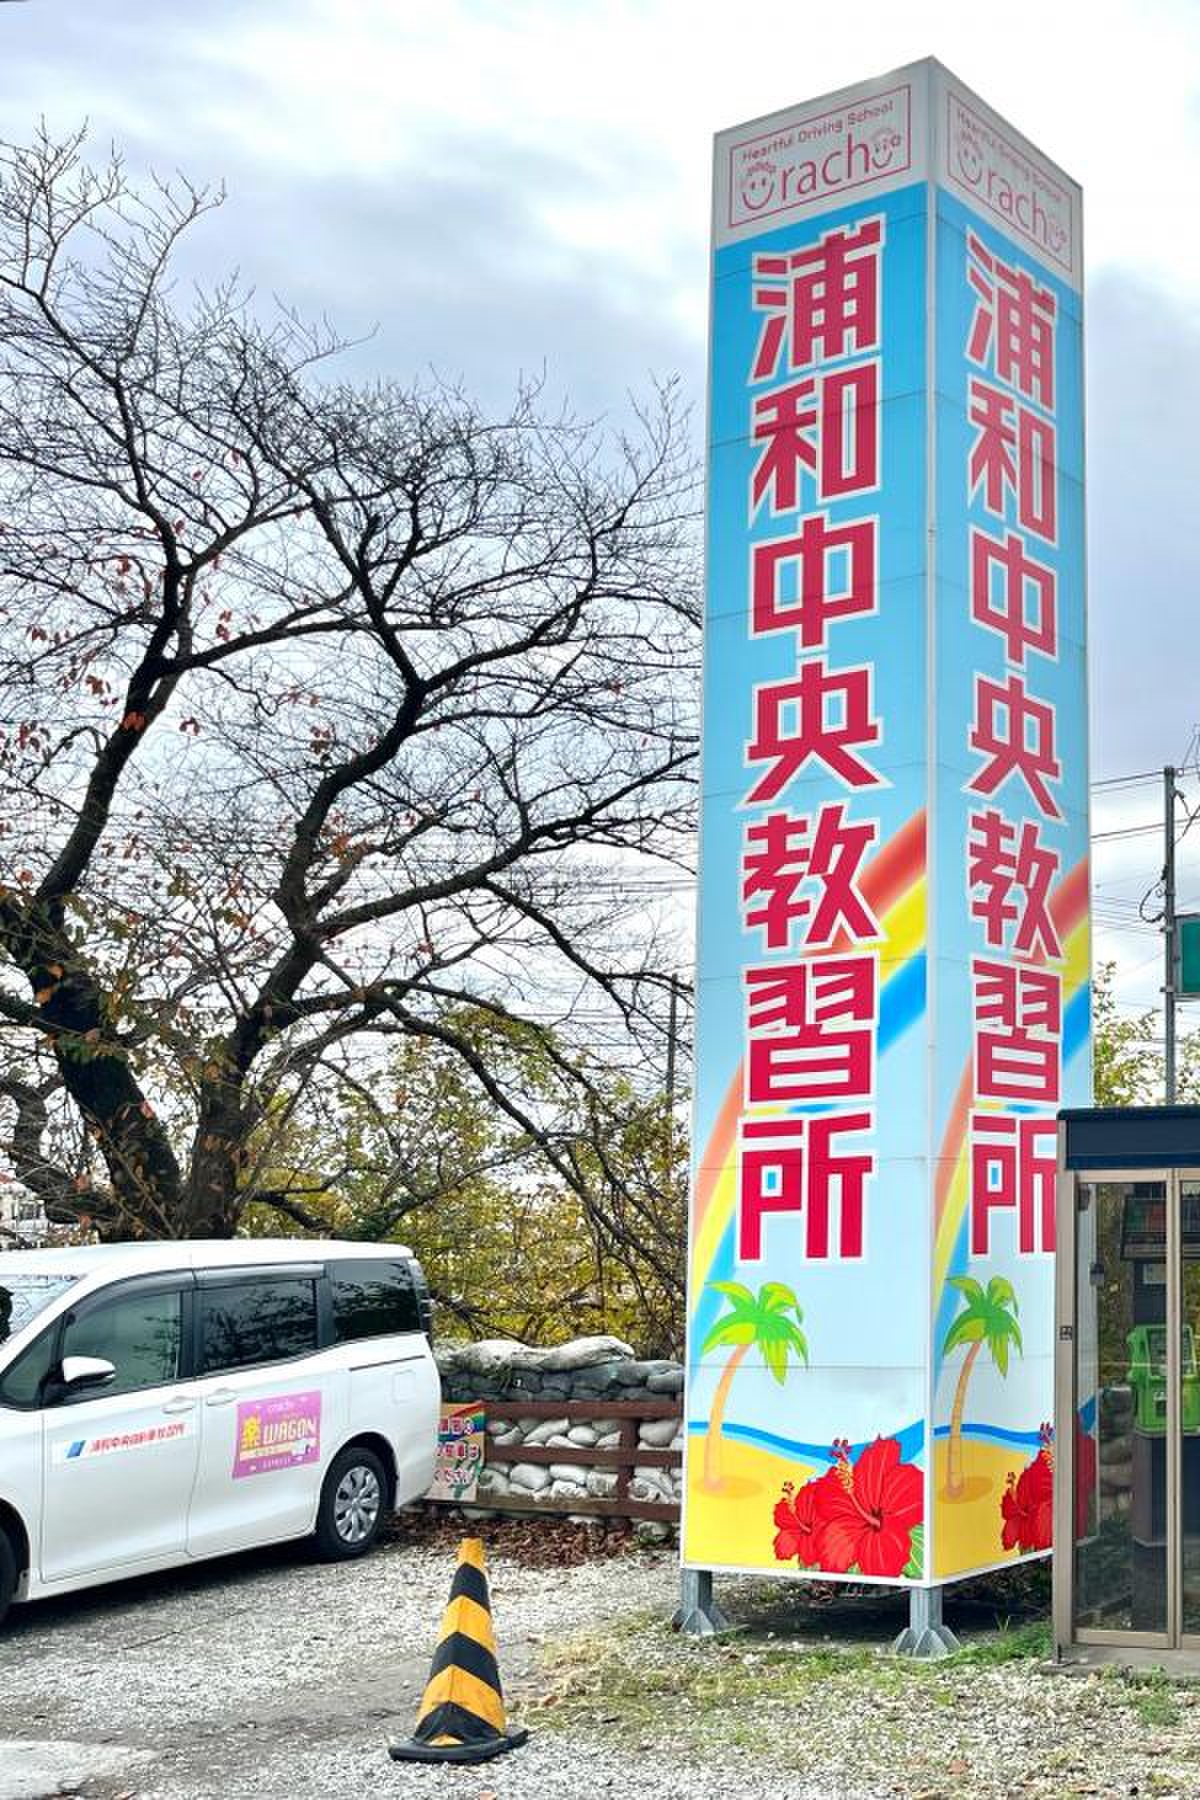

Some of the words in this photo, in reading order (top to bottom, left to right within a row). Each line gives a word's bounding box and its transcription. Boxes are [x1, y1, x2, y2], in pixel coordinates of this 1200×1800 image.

[798, 119, 843, 143] Driving
[847, 99, 894, 126] School
[740, 220, 882, 1261] 浦和中央教習所
[967, 230, 1062, 1256] 浦和中央教習所
